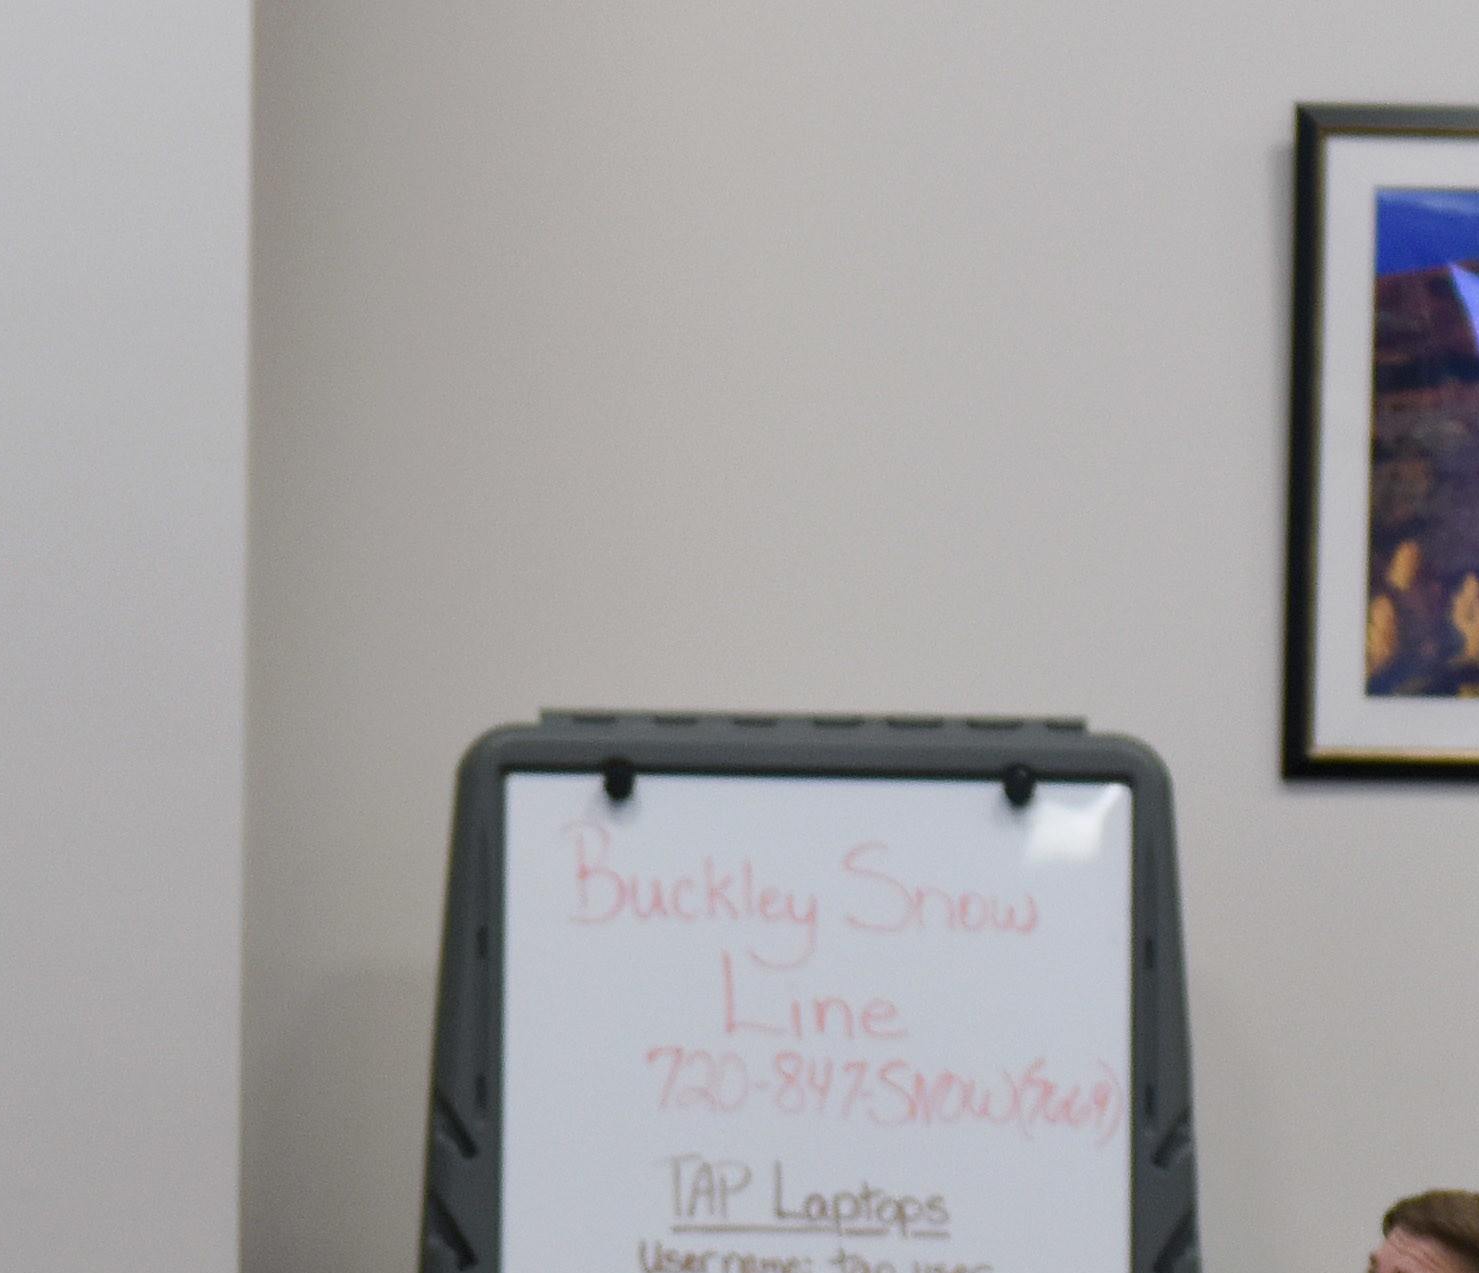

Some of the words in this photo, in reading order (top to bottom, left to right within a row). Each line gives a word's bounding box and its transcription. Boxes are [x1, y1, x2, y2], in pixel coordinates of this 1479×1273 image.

[561, 820, 817, 971] Buckley
[842, 839, 1039, 933] Snow
[721, 949, 911, 1040] Line
[663, 1152, 753, 1221] TAP
[773, 1158, 951, 1240] Laptops
